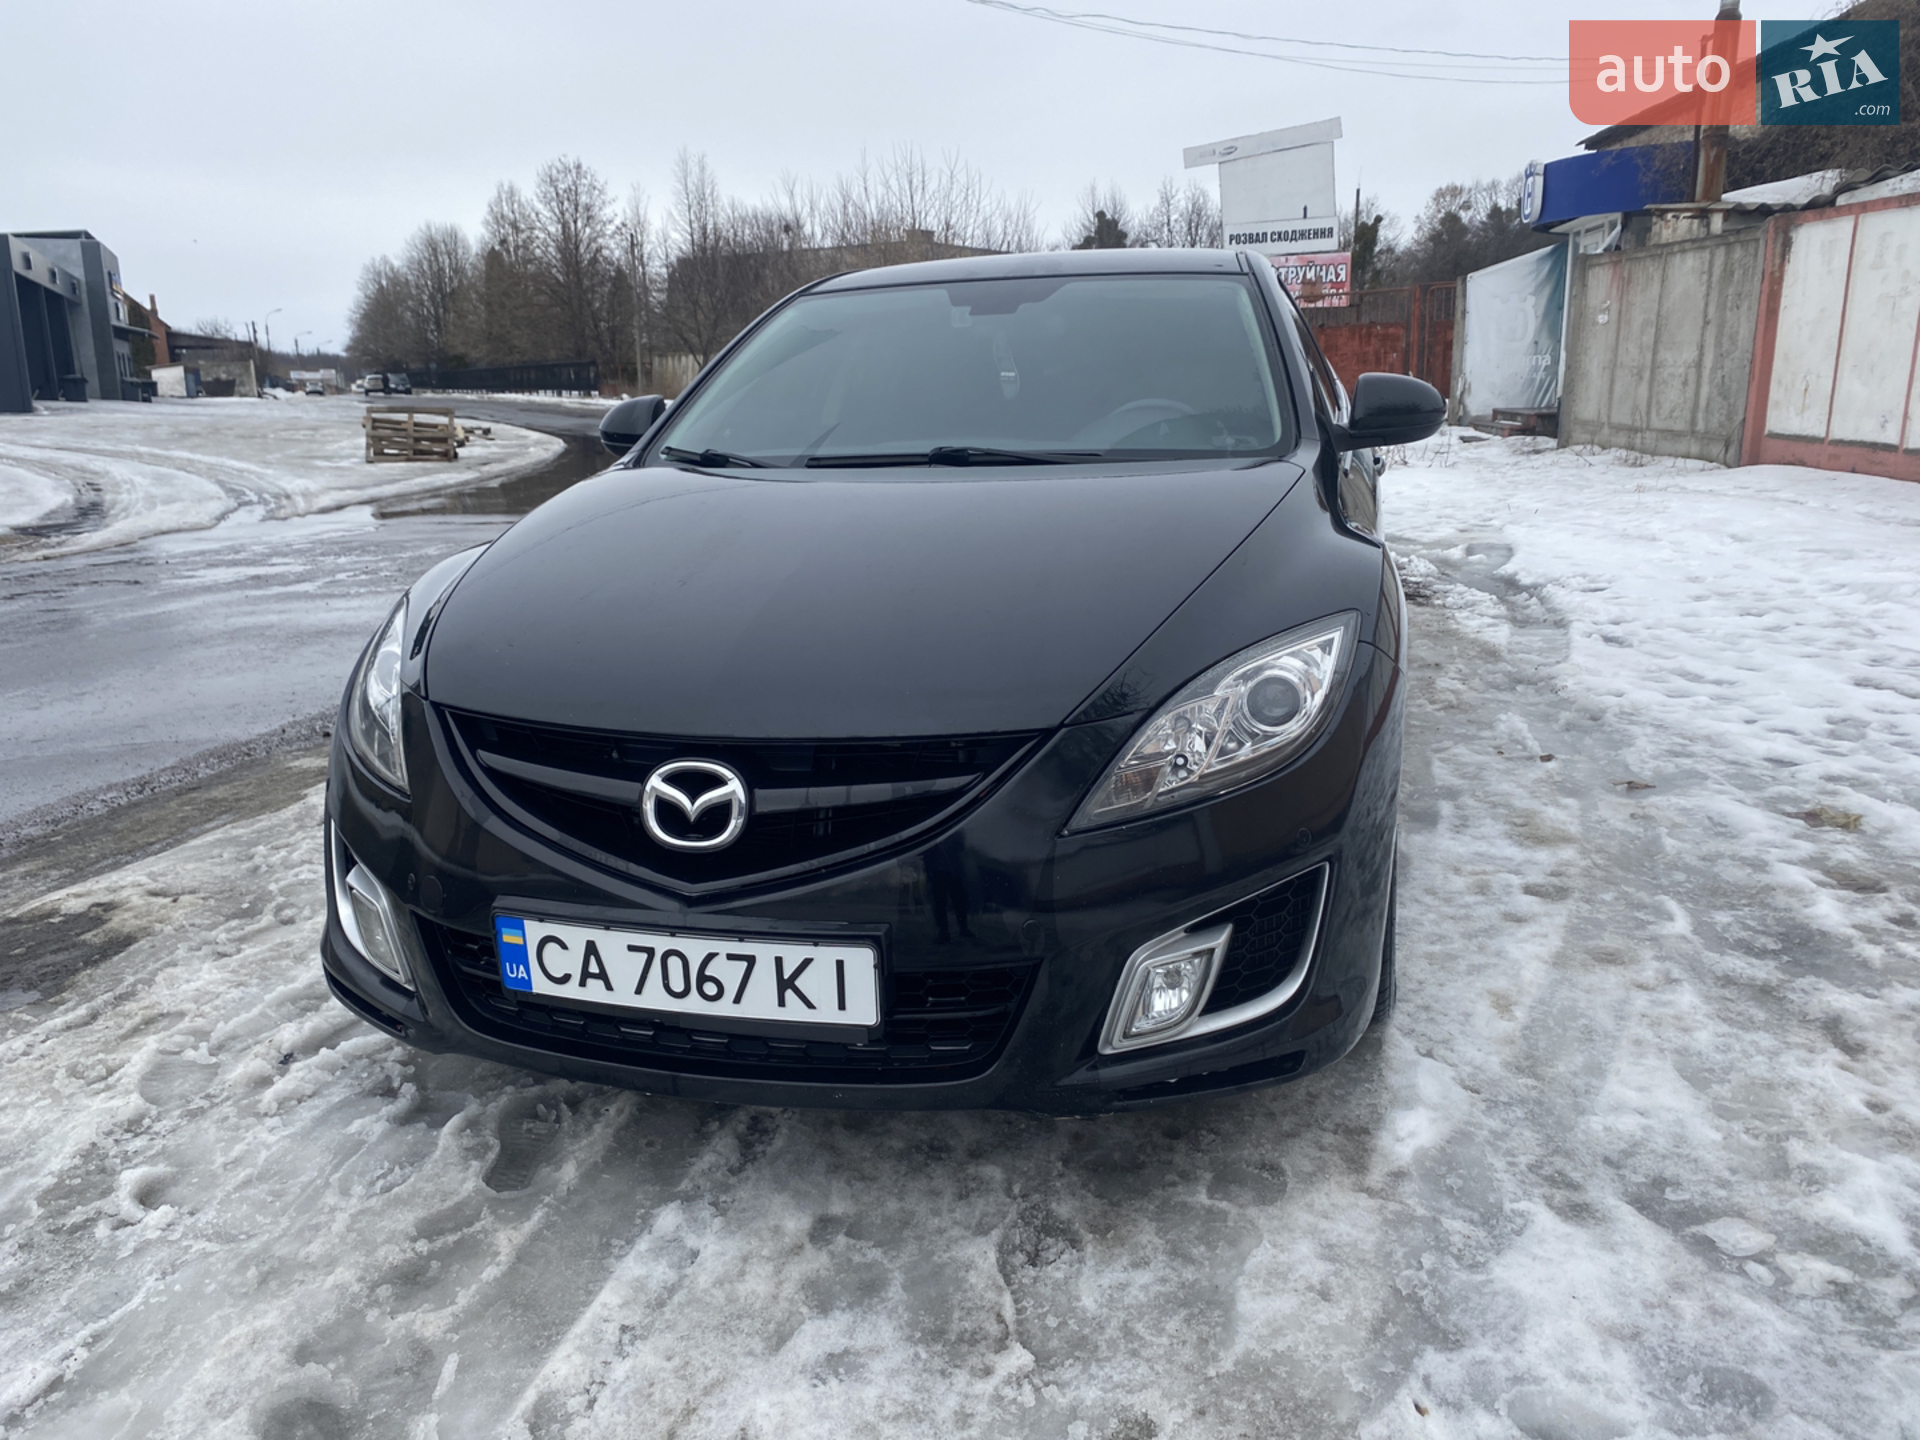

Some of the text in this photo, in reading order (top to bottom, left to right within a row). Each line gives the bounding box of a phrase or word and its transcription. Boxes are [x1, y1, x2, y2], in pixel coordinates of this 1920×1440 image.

[1228, 226, 1334, 246] РОЗВАЛ СХОДЖЕННЯ
[506, 961, 529, 981] UA
[535, 934, 847, 1011] CA 7067 KI
